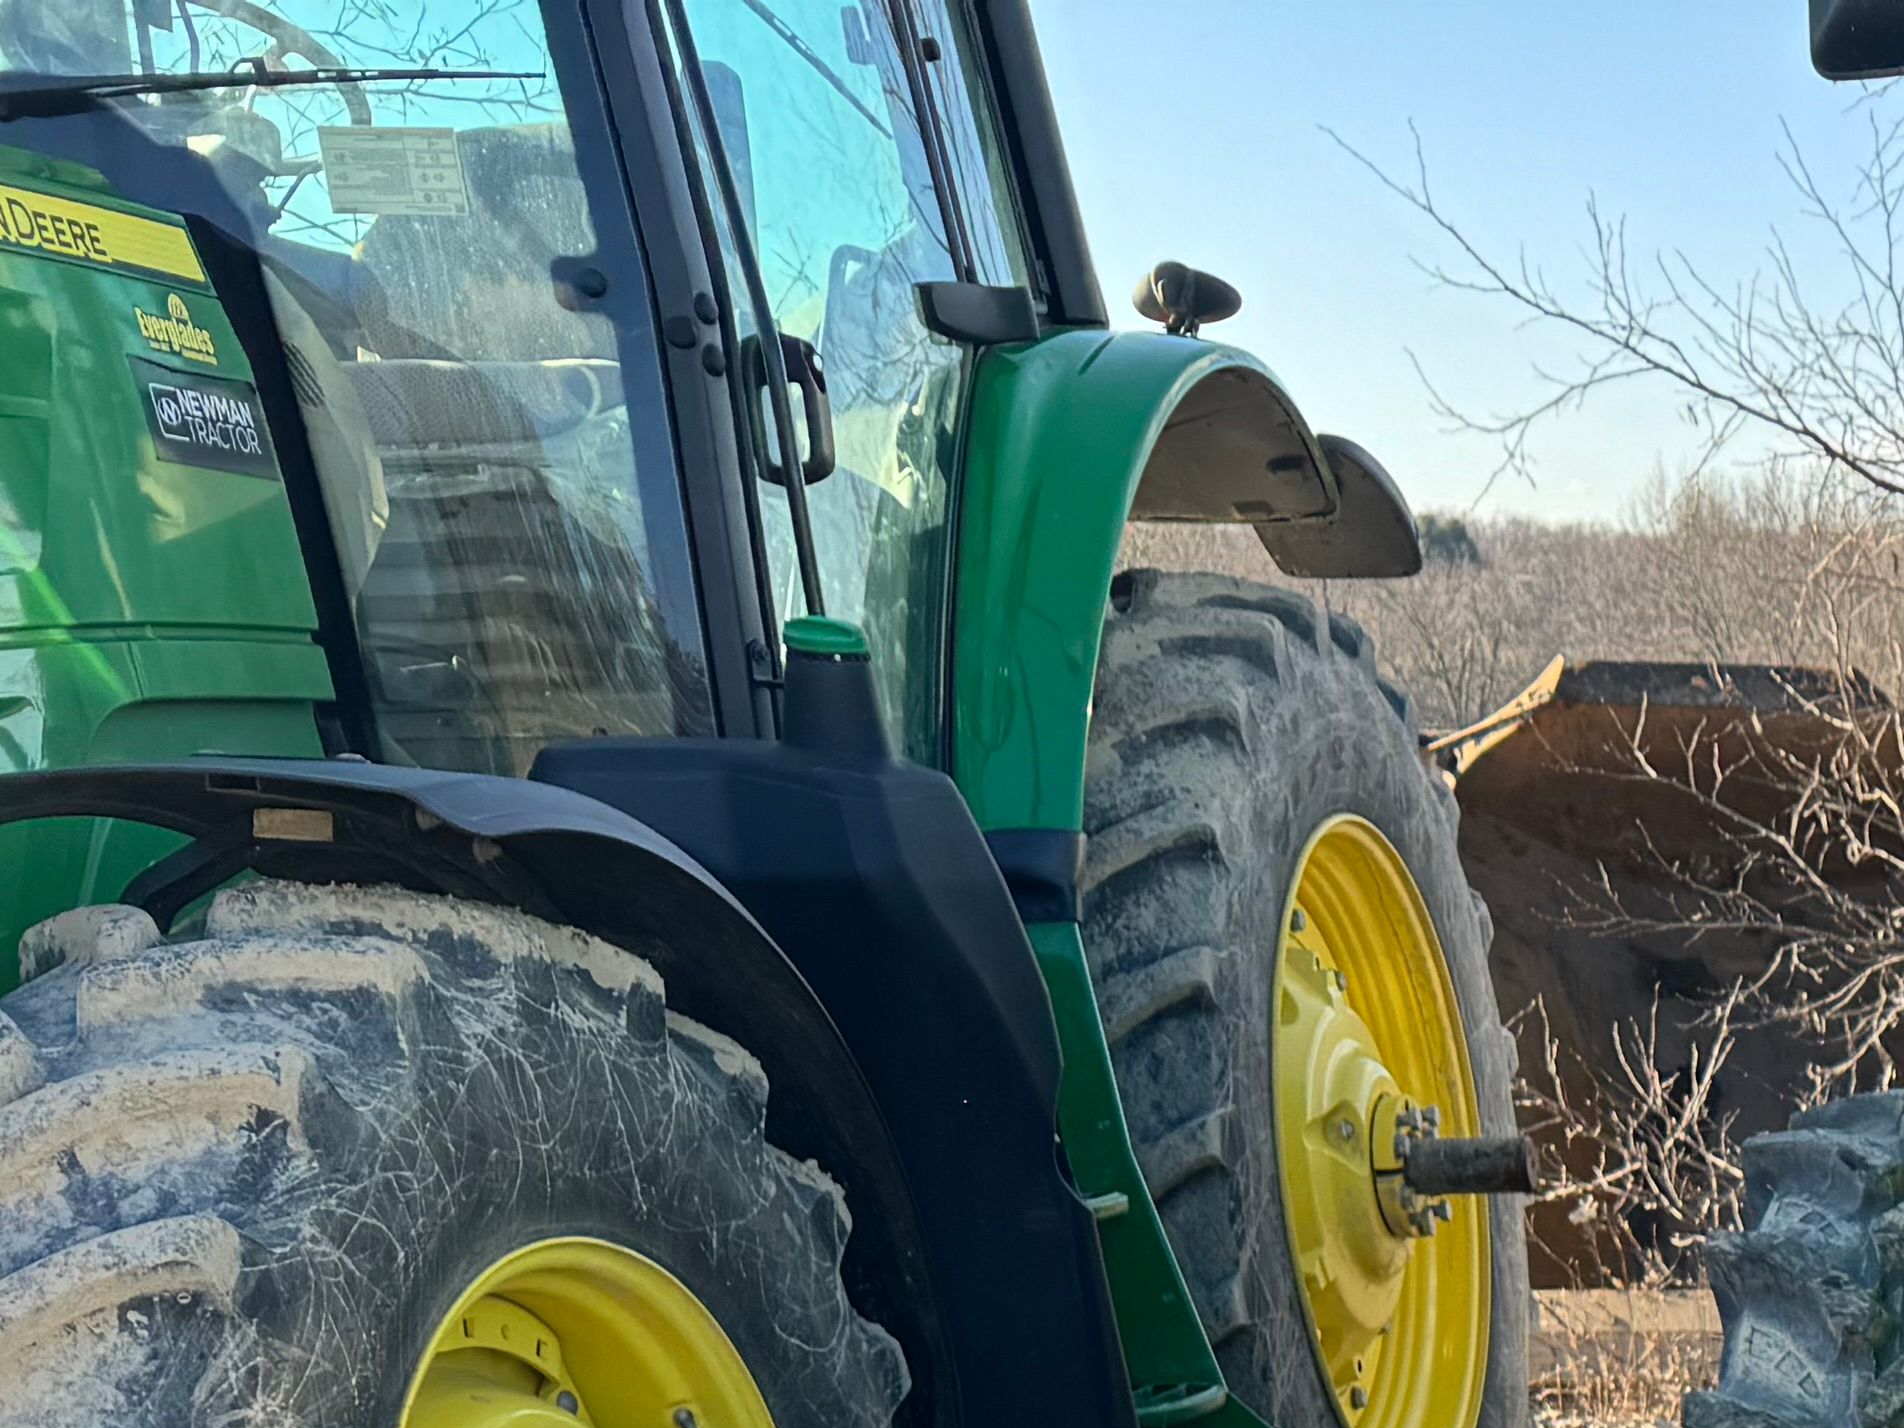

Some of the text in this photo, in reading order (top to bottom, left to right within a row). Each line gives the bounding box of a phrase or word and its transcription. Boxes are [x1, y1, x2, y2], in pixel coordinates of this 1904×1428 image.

[5, 196, 108, 257] DEERE
[134, 306, 216, 355] Everglades
[175, 388, 255, 429] NEWMAN
[184, 415, 262, 455] TRACTOR
